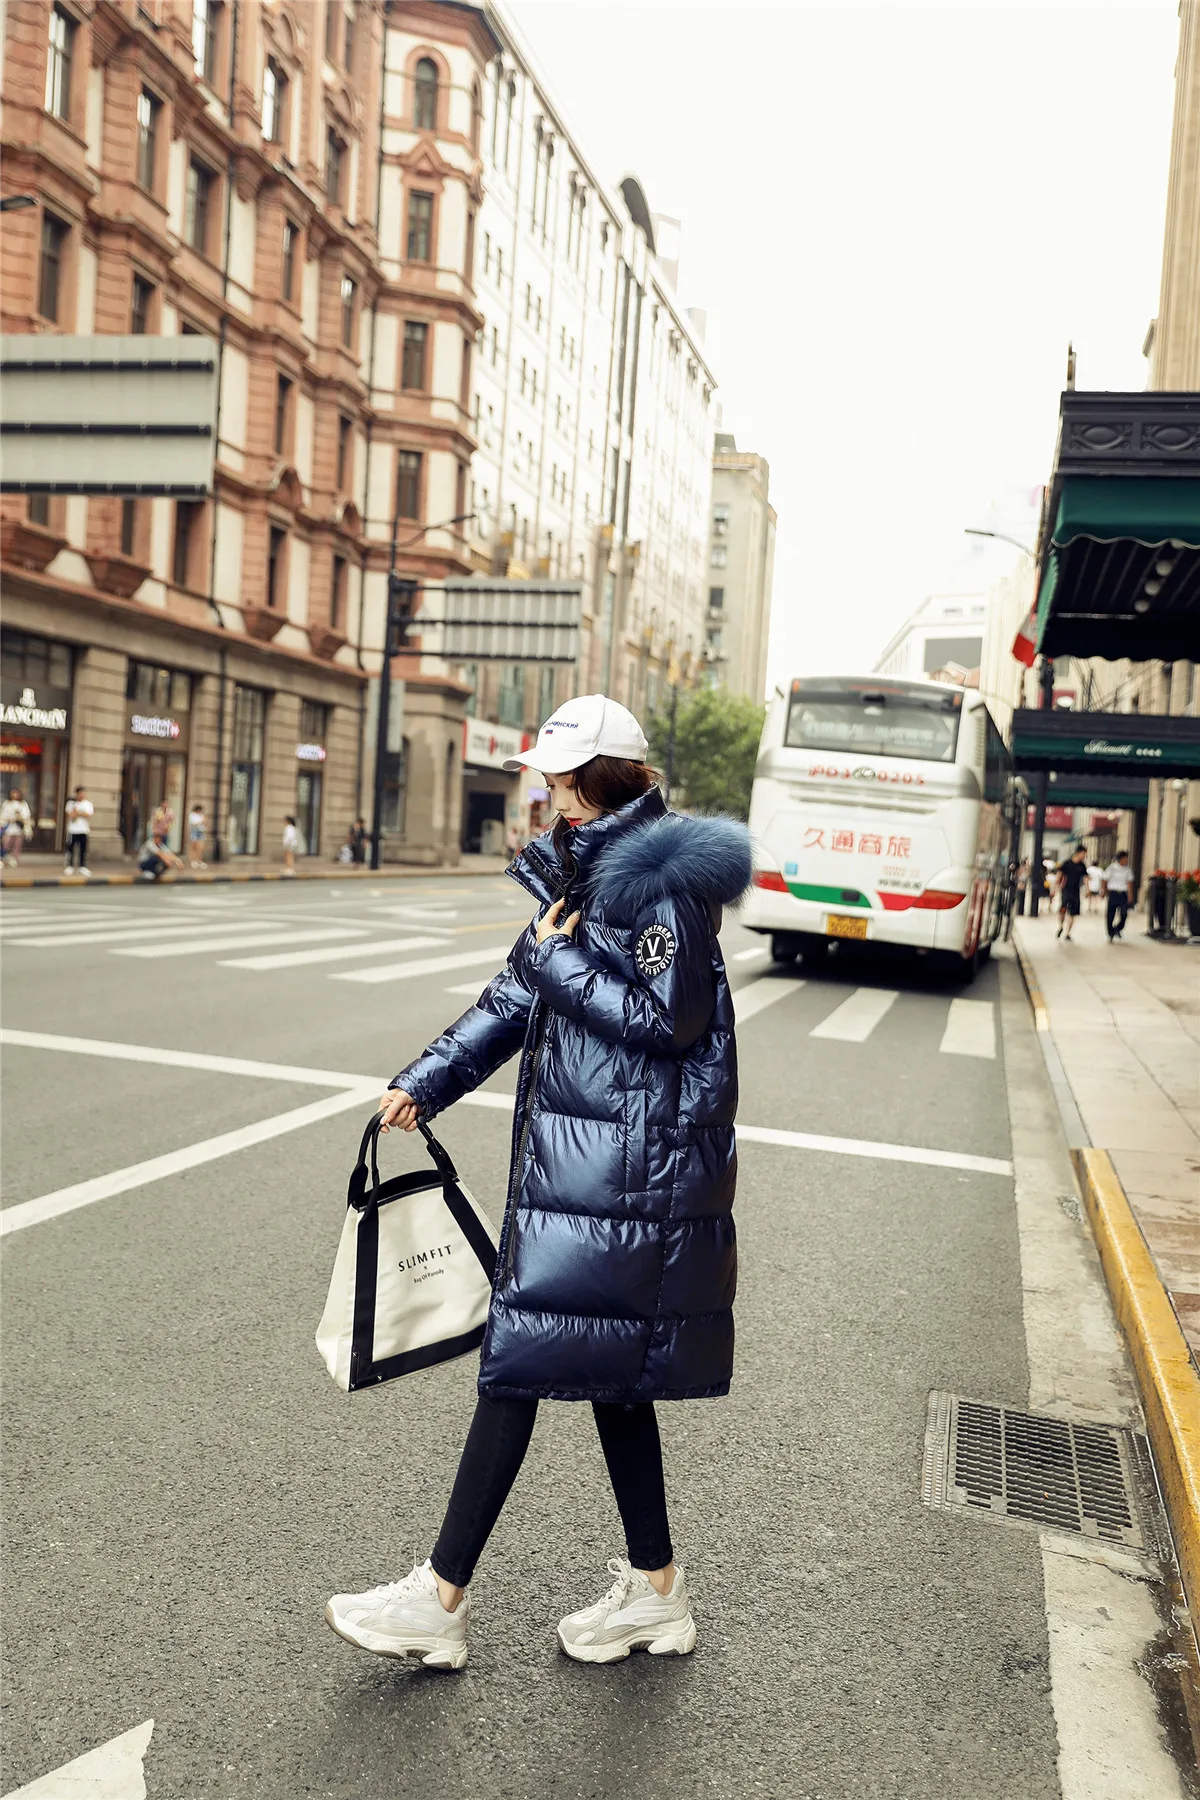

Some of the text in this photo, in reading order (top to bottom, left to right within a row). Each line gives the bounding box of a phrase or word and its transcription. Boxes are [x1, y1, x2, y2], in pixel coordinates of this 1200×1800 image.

[803, 827, 911, 859] 久通商旅
[398, 1244, 452, 1272] SLIMFIT
